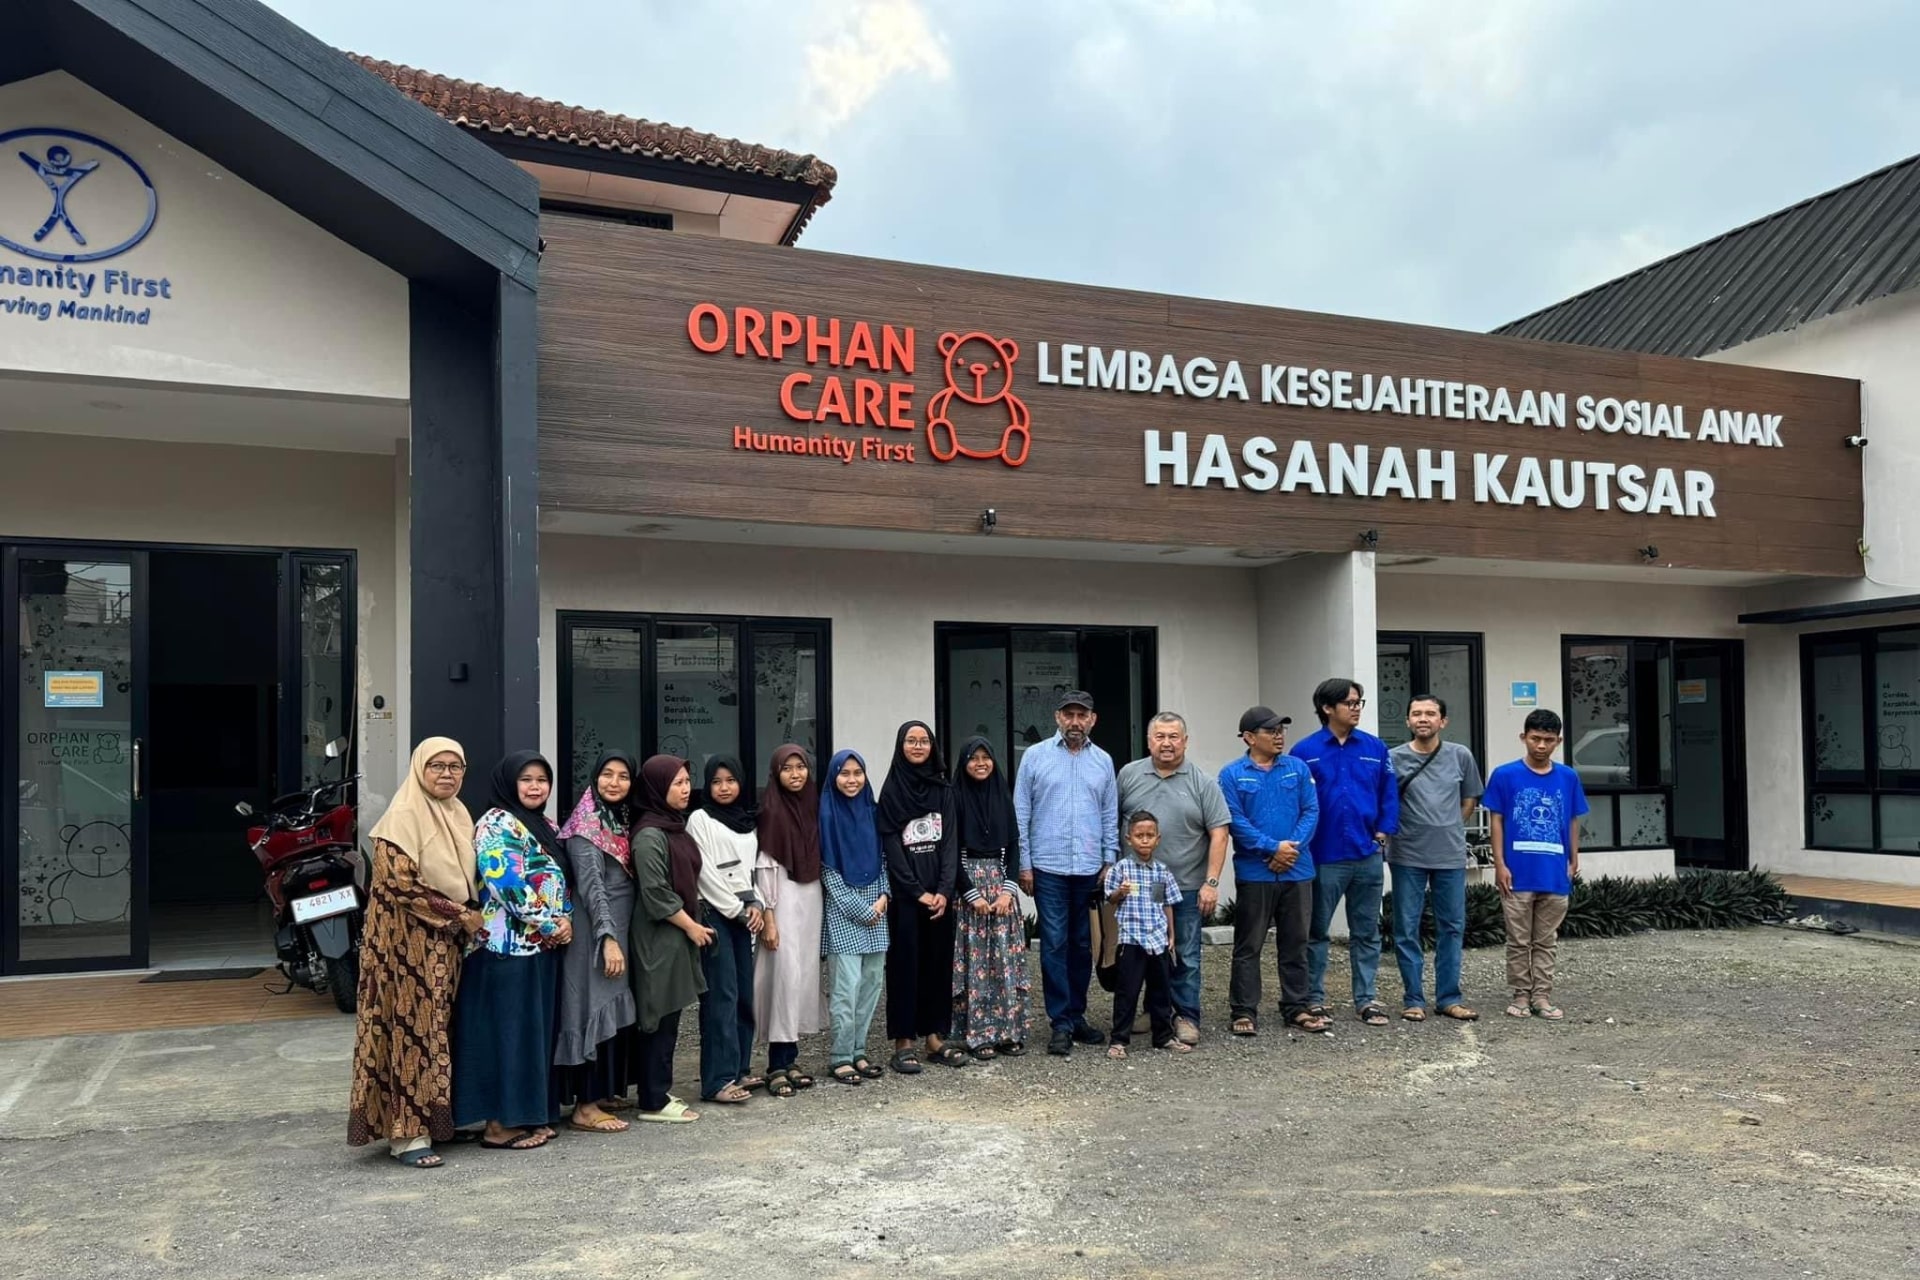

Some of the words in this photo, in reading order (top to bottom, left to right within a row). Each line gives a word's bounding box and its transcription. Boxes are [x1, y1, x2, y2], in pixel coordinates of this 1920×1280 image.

[104, 269, 171, 299] First
[57, 299, 150, 325] Mankind
[687, 302, 915, 373] ORPHAN
[780, 372, 915, 429] CARE
[1038, 341, 1249, 400] LEMBAGA
[1261, 363, 1566, 428] KESEJAHTERAAN
[1576, 395, 1691, 440] SOSIAL
[1697, 408, 1784, 448] ANAK
[734, 426, 856, 463] Humanity
[862, 437, 915, 462] First
[1144, 430, 1456, 501] HASANAH
[1473, 452, 1717, 518] KAUTSAR
[27, 732, 90, 745] ORPHAN
[51, 745, 89, 758] CARE
